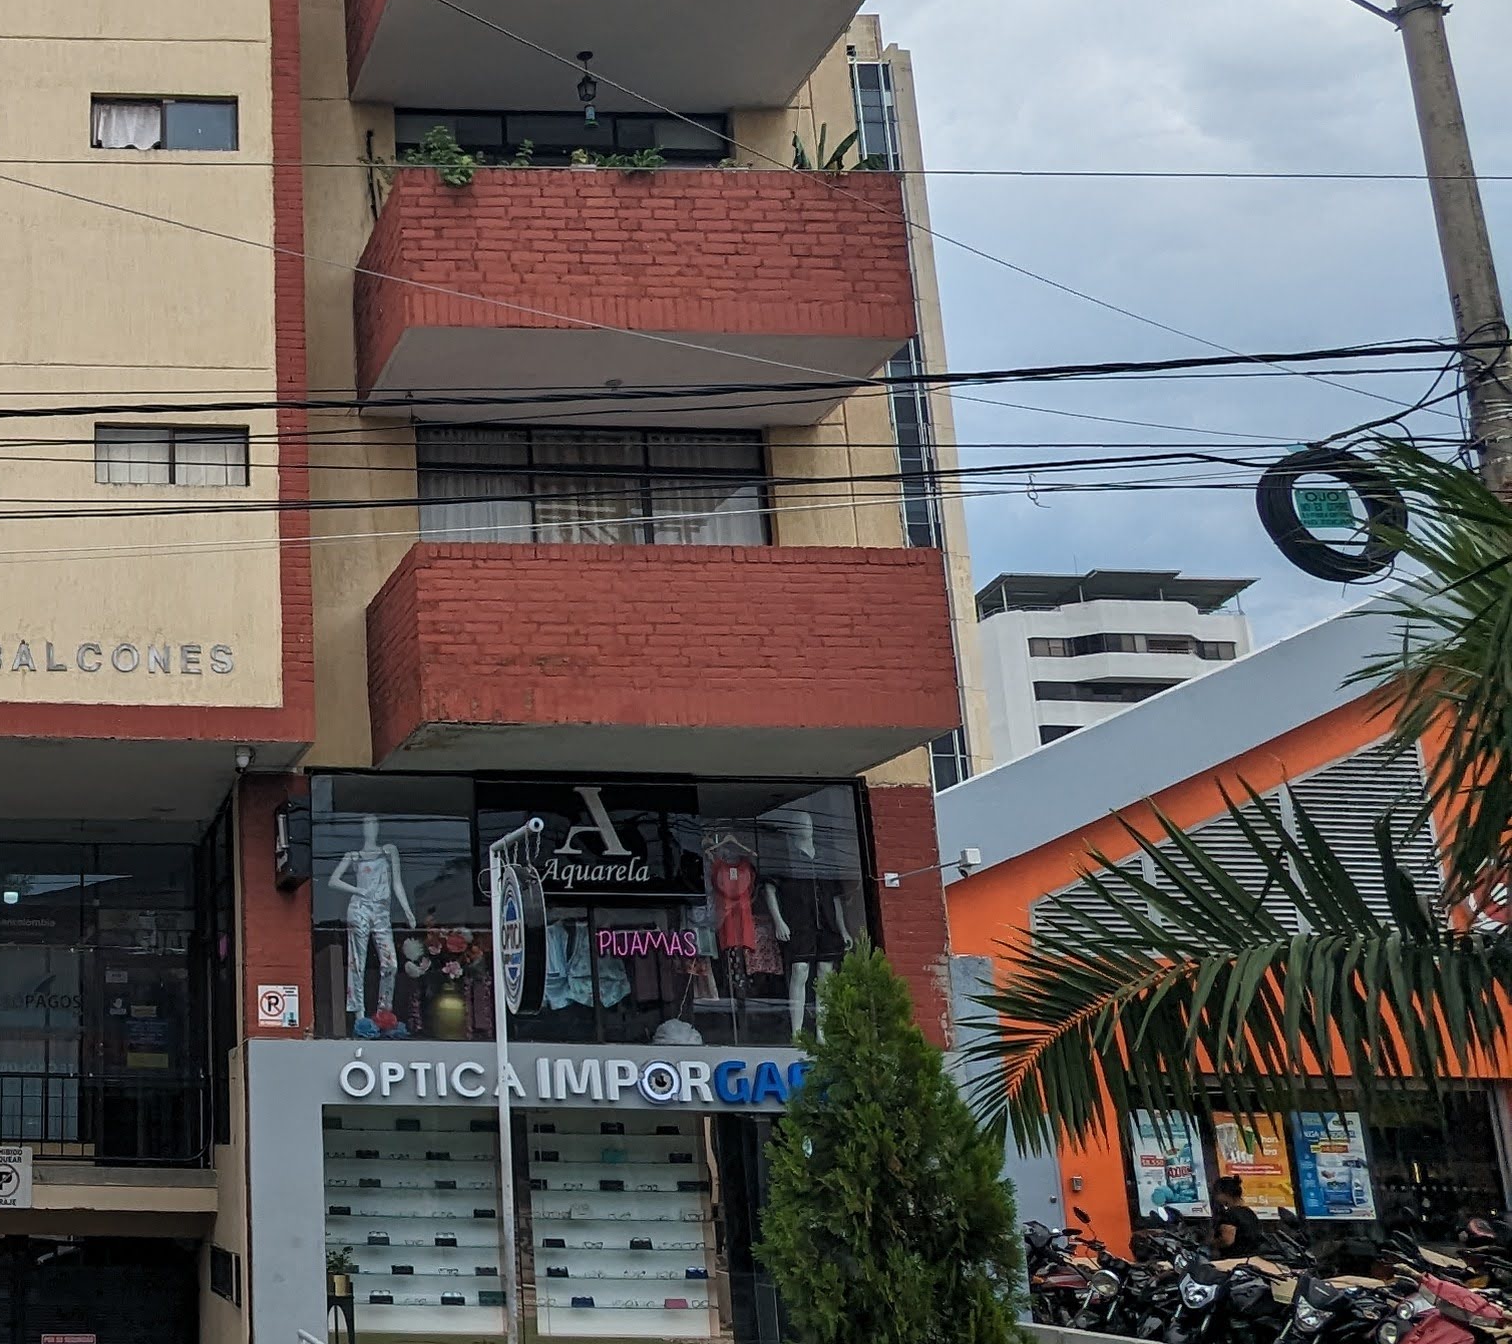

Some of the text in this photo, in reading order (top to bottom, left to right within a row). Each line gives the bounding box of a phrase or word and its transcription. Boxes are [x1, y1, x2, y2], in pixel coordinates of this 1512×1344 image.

[1304, 491, 1339, 502] OJO
[553, 786, 632, 856] A
[541, 856, 650, 889] Aquarela
[597, 929, 697, 956] PIJAMAS
[339, 1047, 527, 1098] ÓPTICA
